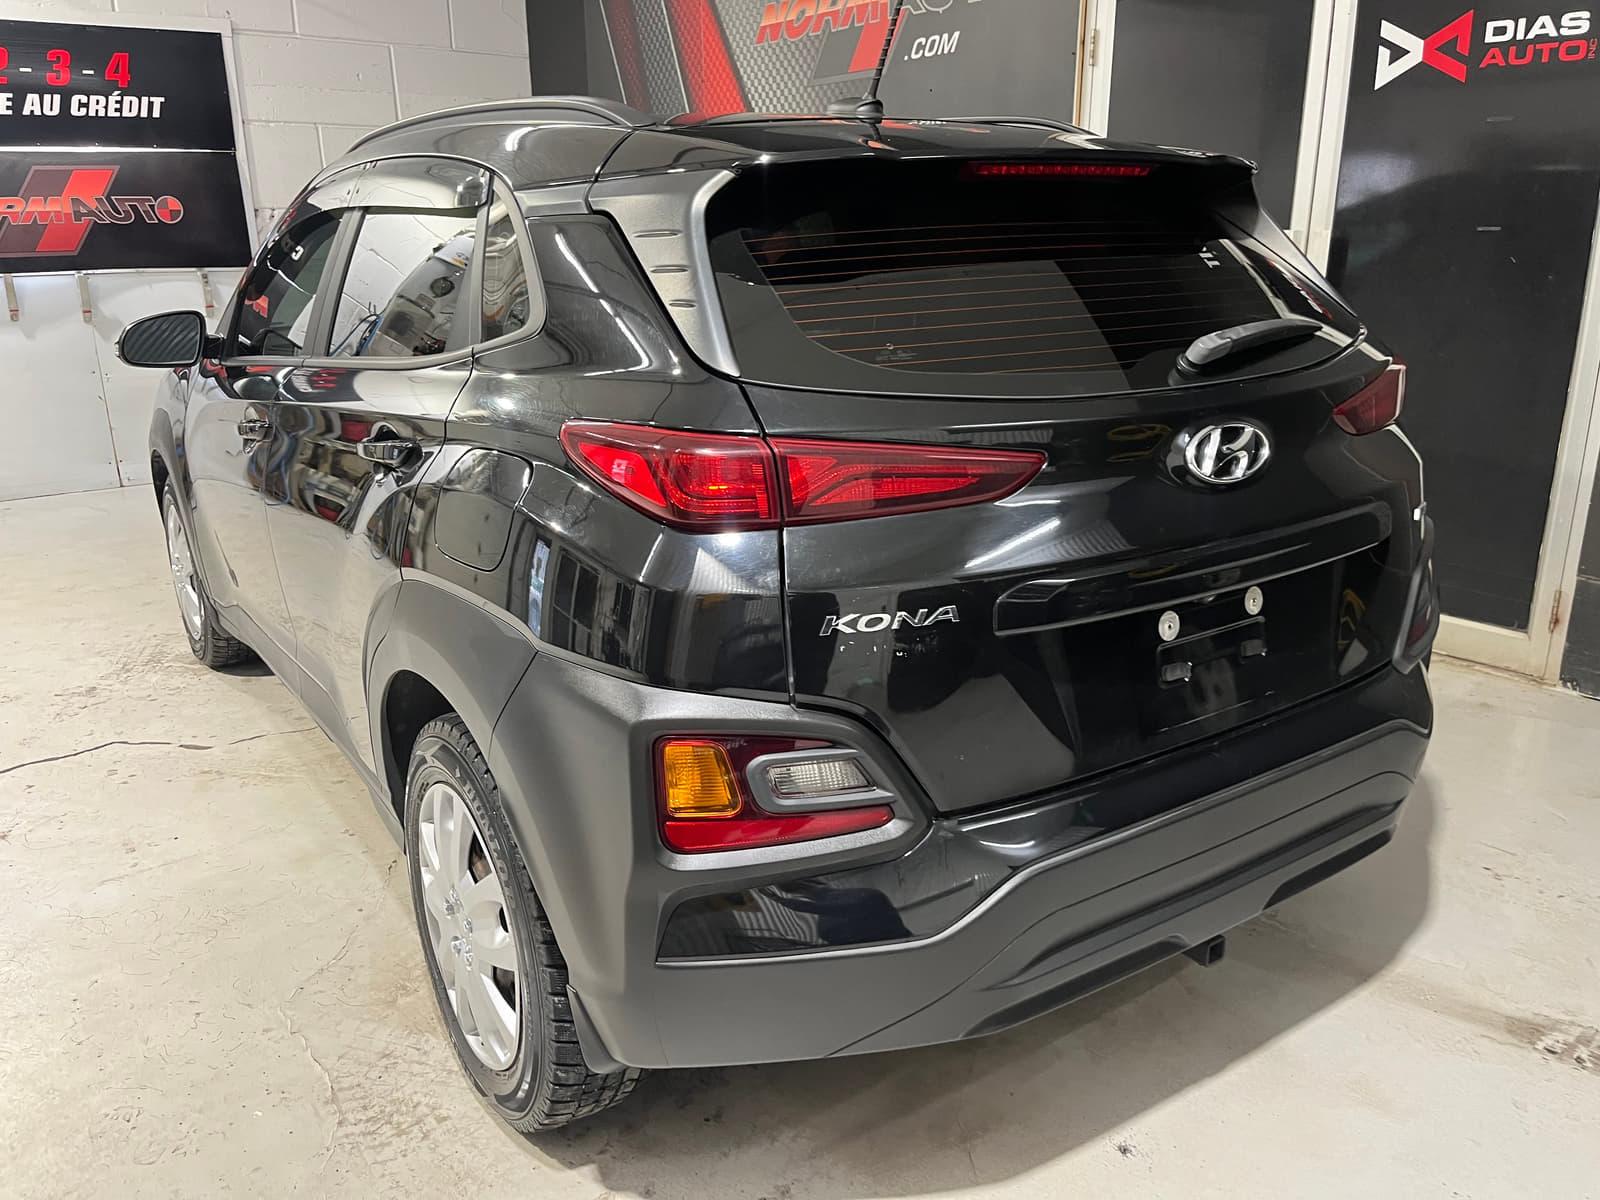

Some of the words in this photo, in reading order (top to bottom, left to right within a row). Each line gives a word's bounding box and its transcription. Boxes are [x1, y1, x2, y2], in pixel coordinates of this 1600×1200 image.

[1484, 11, 1591, 43] DIAS
[904, 31, 960, 60] .COM
[1479, 39, 1588, 68] AUTO
[46, 49, 71, 87] 3
[104, 52, 131, 88] 4
[22, 93, 61, 116] AU
[70, 91, 165, 118] CRÉDIT
[819, 605, 960, 636] KONA
